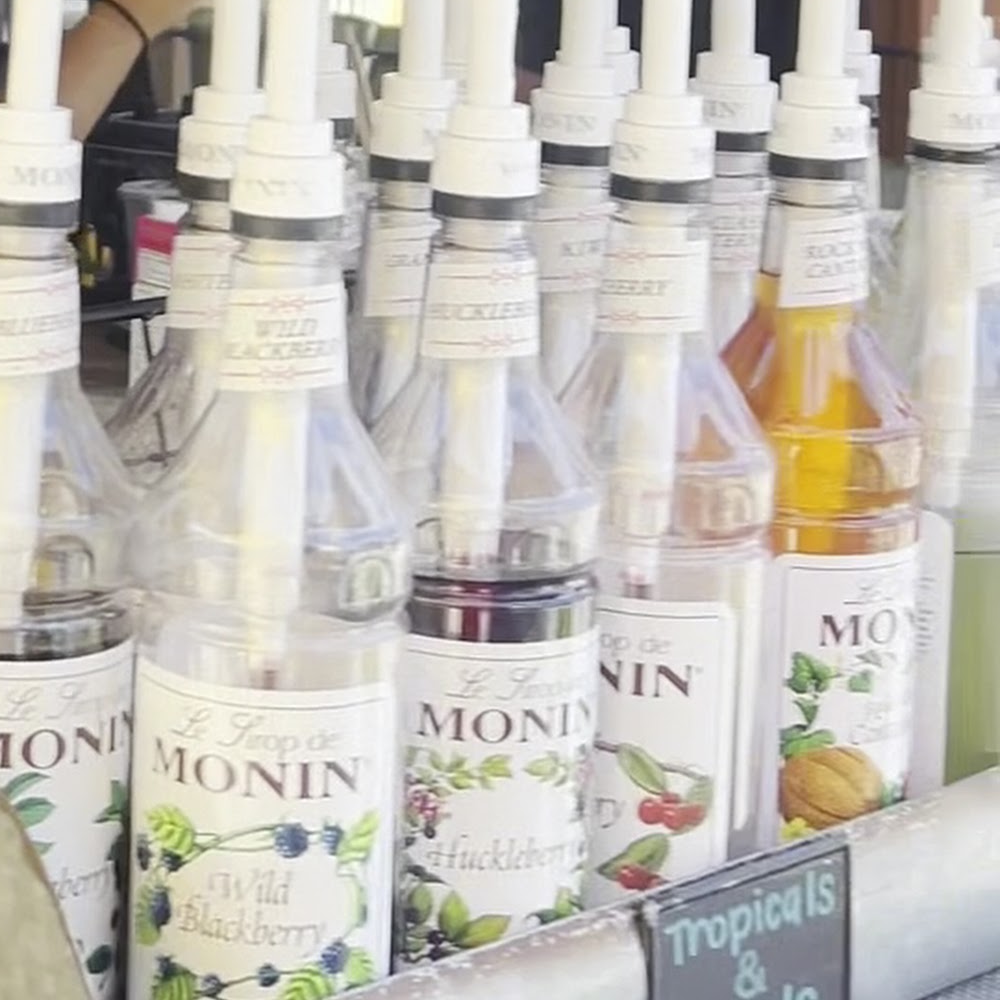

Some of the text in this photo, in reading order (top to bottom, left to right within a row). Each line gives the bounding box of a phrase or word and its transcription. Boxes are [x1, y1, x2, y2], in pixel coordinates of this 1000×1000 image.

[599, 659, 692, 699] NIN
[151, 735, 364, 801] MONIN
[205, 867, 295, 907] Wild
[175, 894, 330, 959] Blackberry
[663, 870, 837, 967] Tropicals
[732, 948, 768, 1000] &
